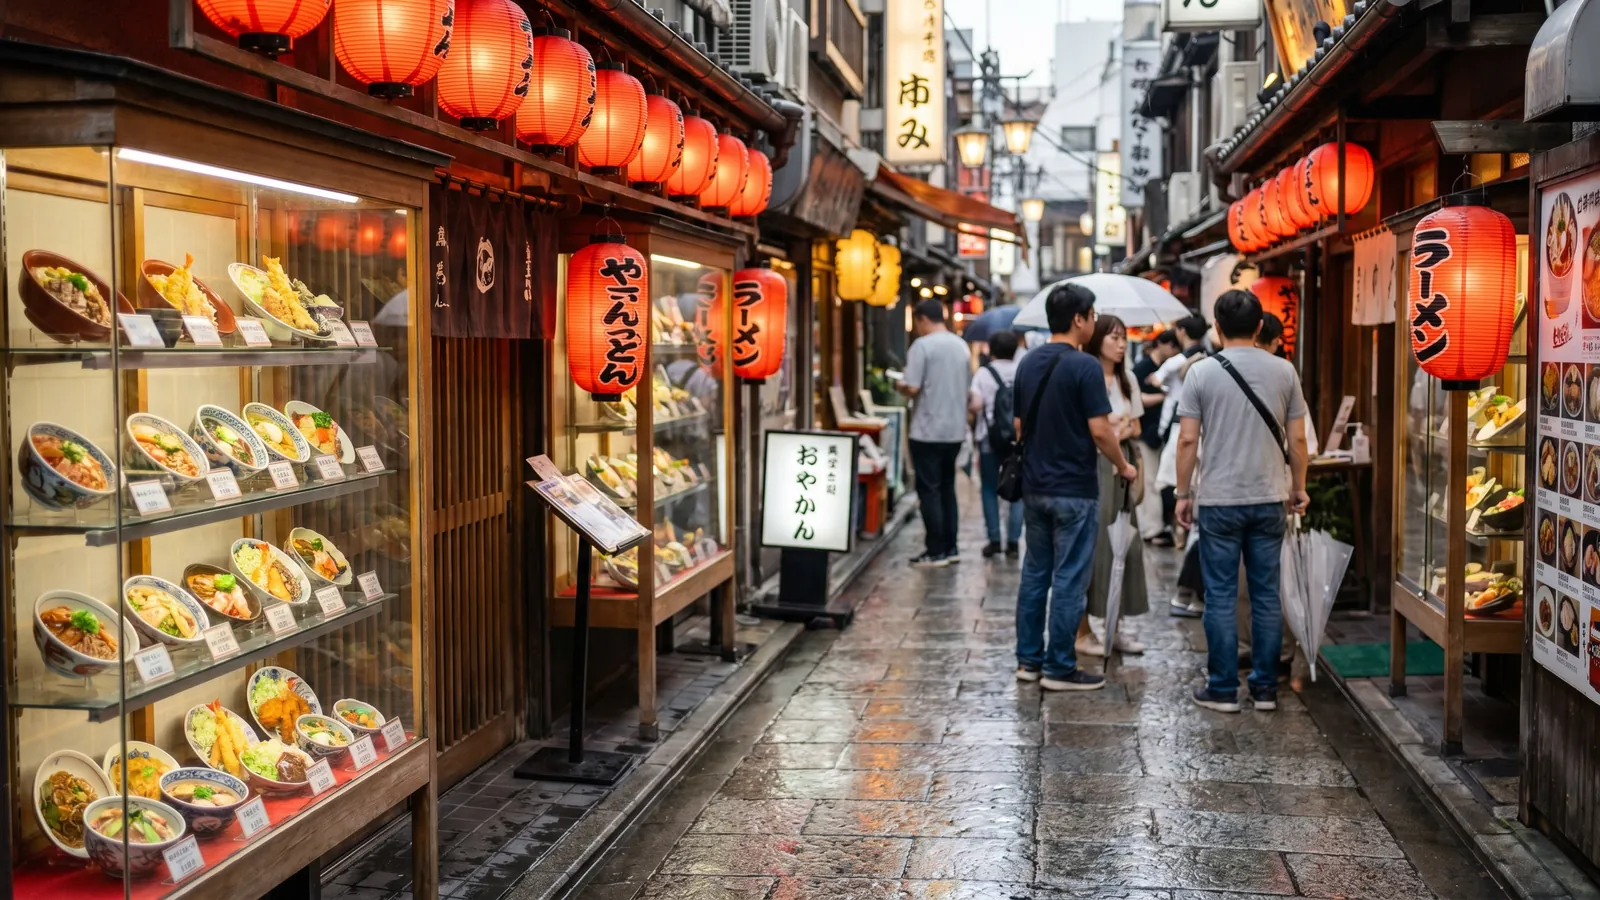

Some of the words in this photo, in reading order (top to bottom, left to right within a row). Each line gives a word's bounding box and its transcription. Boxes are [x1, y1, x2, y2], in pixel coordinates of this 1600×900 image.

[733, 282, 762, 367] ラーメン
[1413, 229, 1451, 363] ラーメン
[793, 443, 818, 541] おやかん
